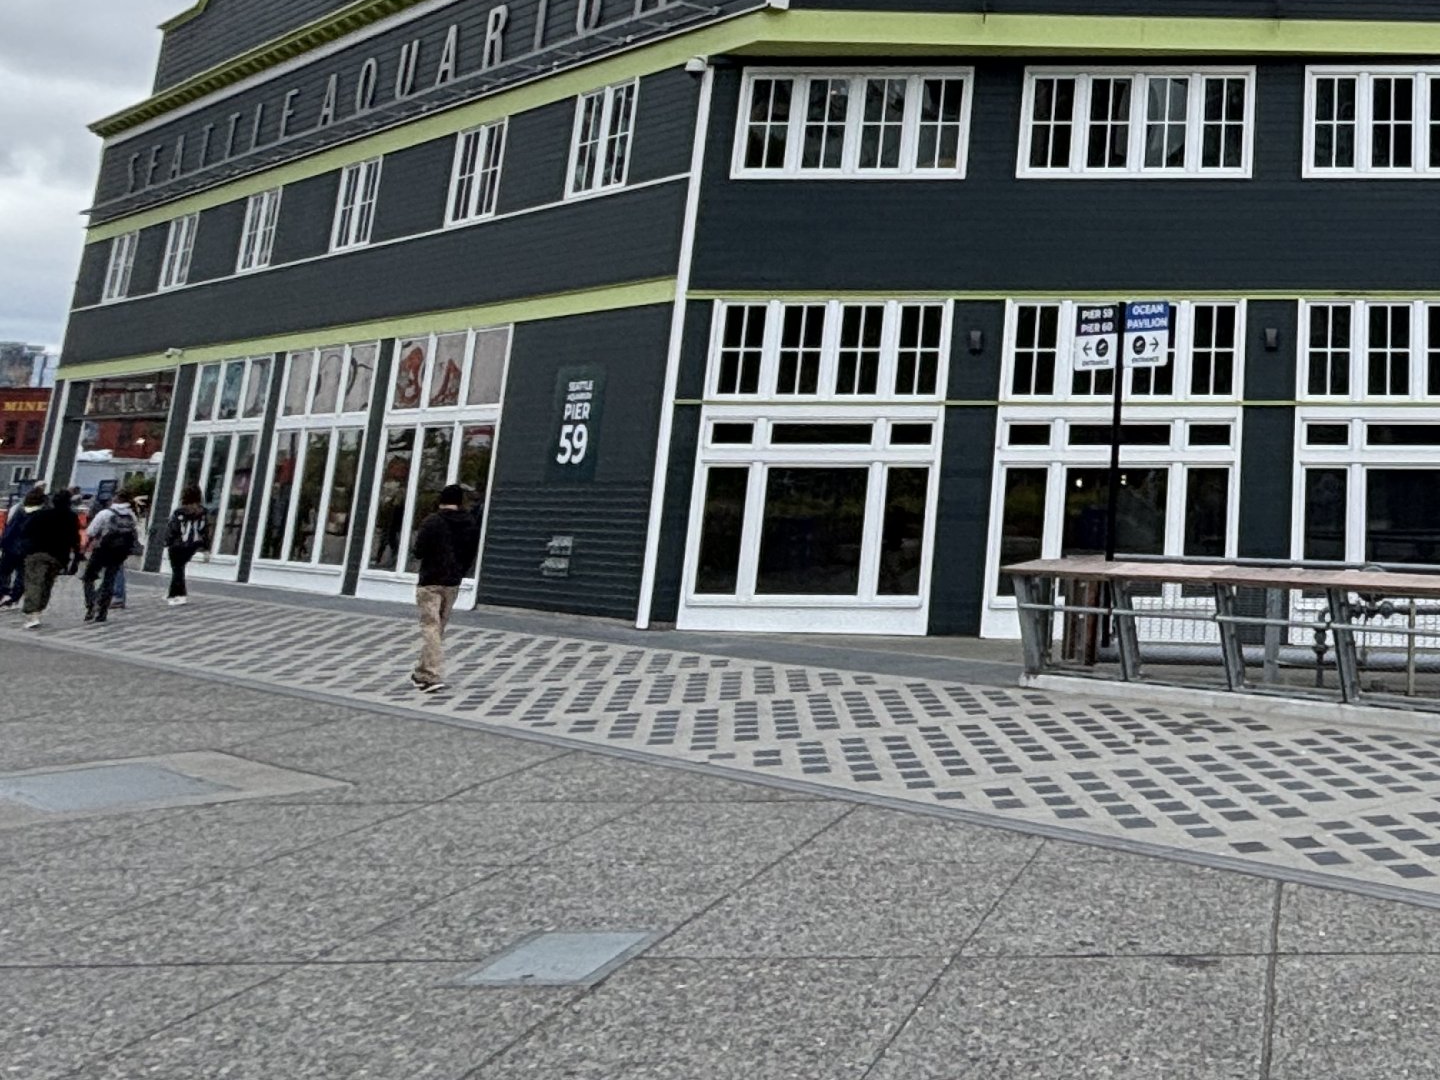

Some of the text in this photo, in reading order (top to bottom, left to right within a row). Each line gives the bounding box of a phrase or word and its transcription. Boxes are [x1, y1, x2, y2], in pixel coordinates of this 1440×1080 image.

[127, 88, 299, 193] SEATTLE
[1081, 308, 1113, 320] PIER 59
[1132, 304, 1164, 315] OCEAN
[1080, 321, 1113, 334] PIER 60
[1126, 317, 1168, 330] PAVILION
[563, 402, 591, 421] PIER
[556, 423, 589, 464] 59
